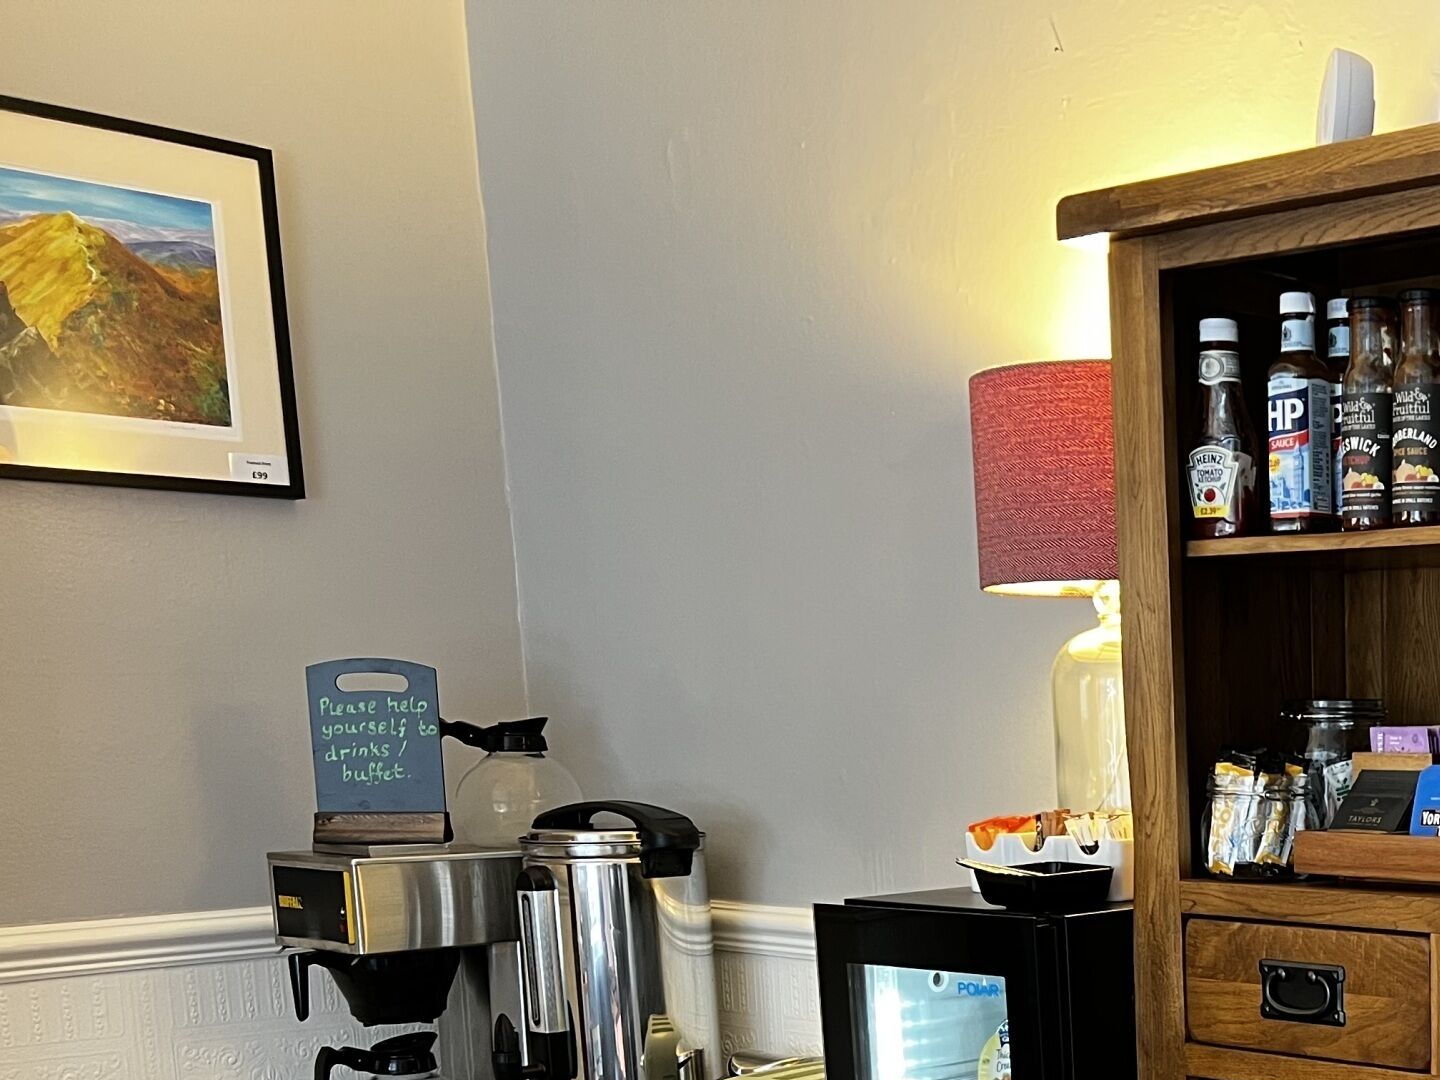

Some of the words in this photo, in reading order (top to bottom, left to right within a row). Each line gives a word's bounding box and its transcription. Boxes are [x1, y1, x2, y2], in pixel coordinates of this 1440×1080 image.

[1268, 397, 1305, 432] HP
[1343, 409, 1375, 425] ruitful
[1271, 438, 1295, 449] SAUCE
[1196, 453, 1223, 465] HEINZ
[1197, 468, 1224, 477] TOMATO
[319, 697, 377, 716] Please
[387, 696, 428, 718] help
[322, 718, 407, 741] yourself
[418, 720, 438, 737] to
[325, 742, 390, 763] drinks
[957, 982, 1000, 997] POLAR
[996, 1048, 1010, 1061] Thic
